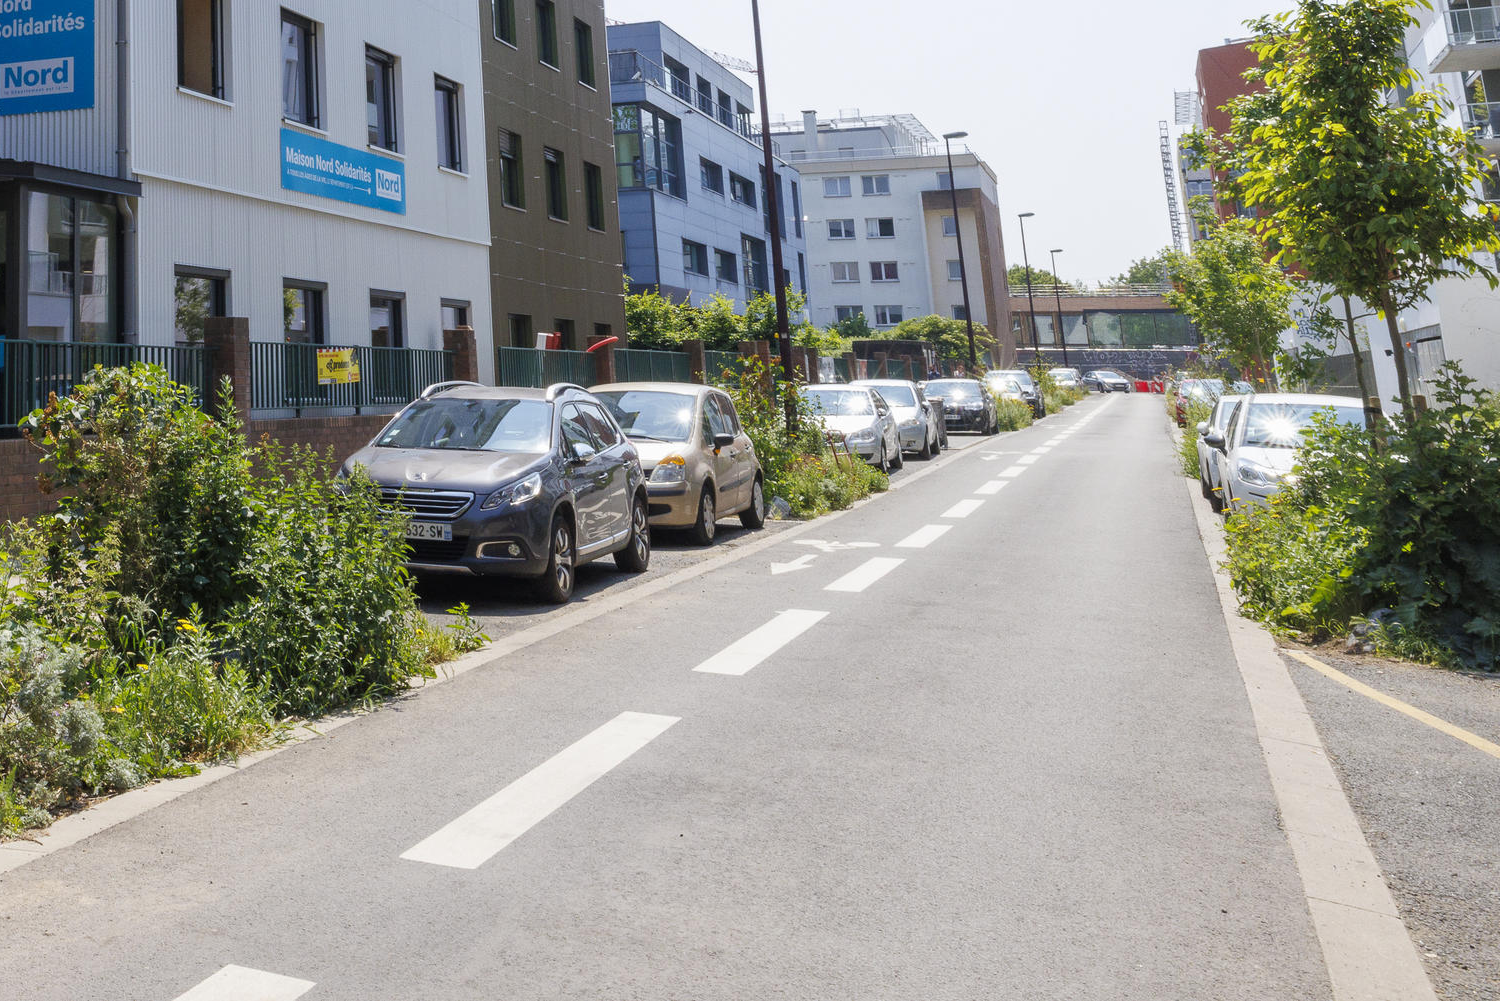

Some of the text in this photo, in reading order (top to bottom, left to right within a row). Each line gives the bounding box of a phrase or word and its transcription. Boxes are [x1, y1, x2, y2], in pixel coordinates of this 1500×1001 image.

[4, 60, 68, 89] Nord
[286, 146, 371, 183] Maison Nord Solidarités
[378, 172, 399, 193] Nord
